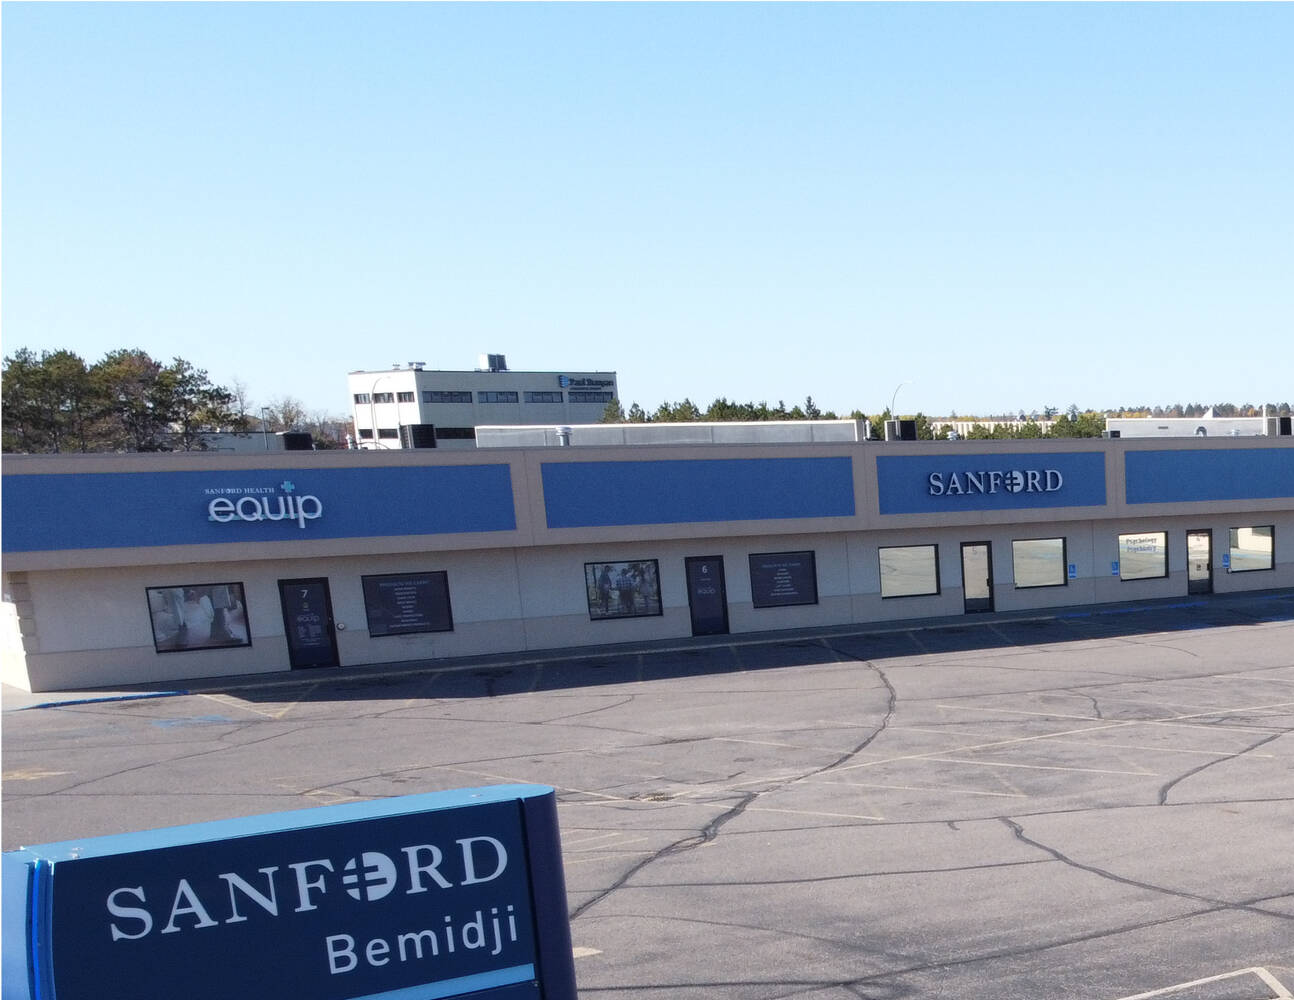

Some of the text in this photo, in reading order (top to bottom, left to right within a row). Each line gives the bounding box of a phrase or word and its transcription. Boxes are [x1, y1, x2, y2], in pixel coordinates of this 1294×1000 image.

[929, 469, 1064, 496] SANFORD
[208, 494, 323, 529] equip
[702, 565, 708, 574] 6
[300, 589, 309, 599] 7
[106, 835, 509, 942] SANFORD
[325, 904, 518, 975] Bemidji
